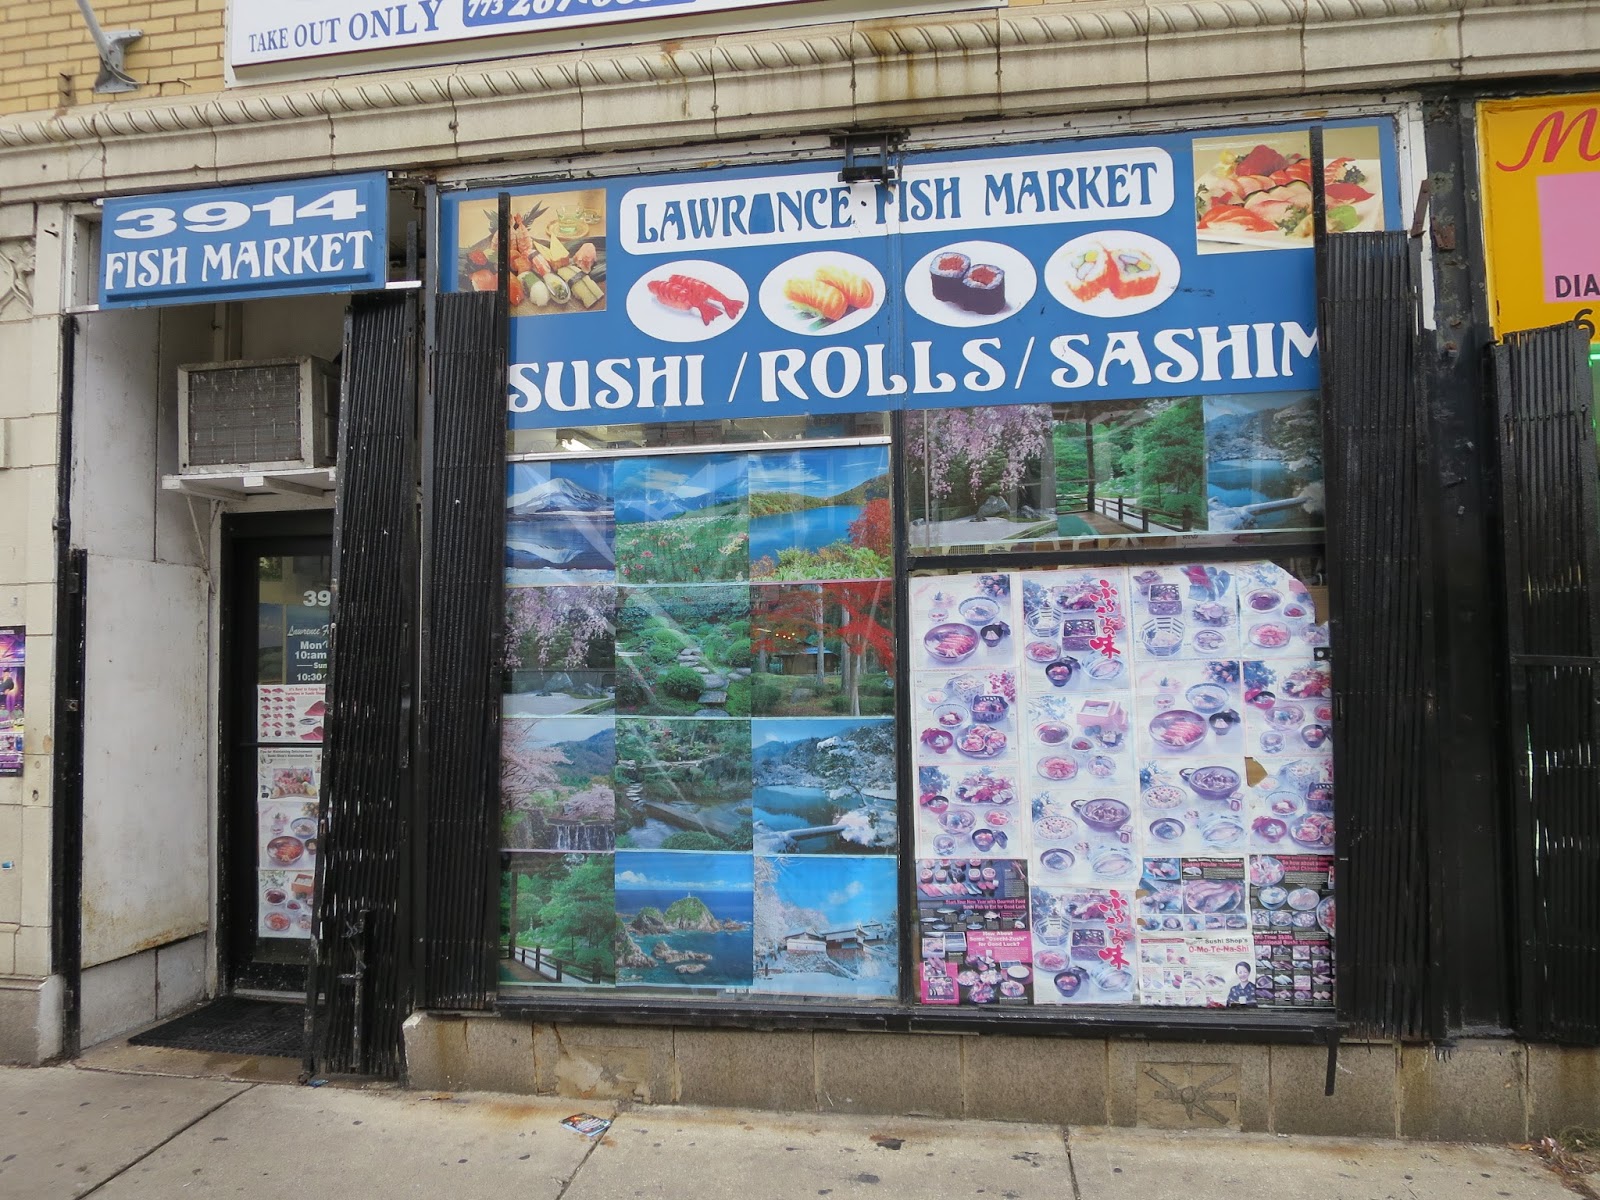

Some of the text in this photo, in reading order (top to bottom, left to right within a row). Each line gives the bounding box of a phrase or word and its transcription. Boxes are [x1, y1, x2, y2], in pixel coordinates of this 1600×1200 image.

[249, 0, 444, 53] TAKE OUT ONLY
[467, 0, 504, 18] 773
[113, 188, 367, 239] 3914
[636, 162, 1158, 244] LAWRNCE FISH MARKET
[104, 230, 373, 290] FISH MARKET
[507, 354, 705, 413] SUSHI
[758, 337, 1006, 402] ROLLS
